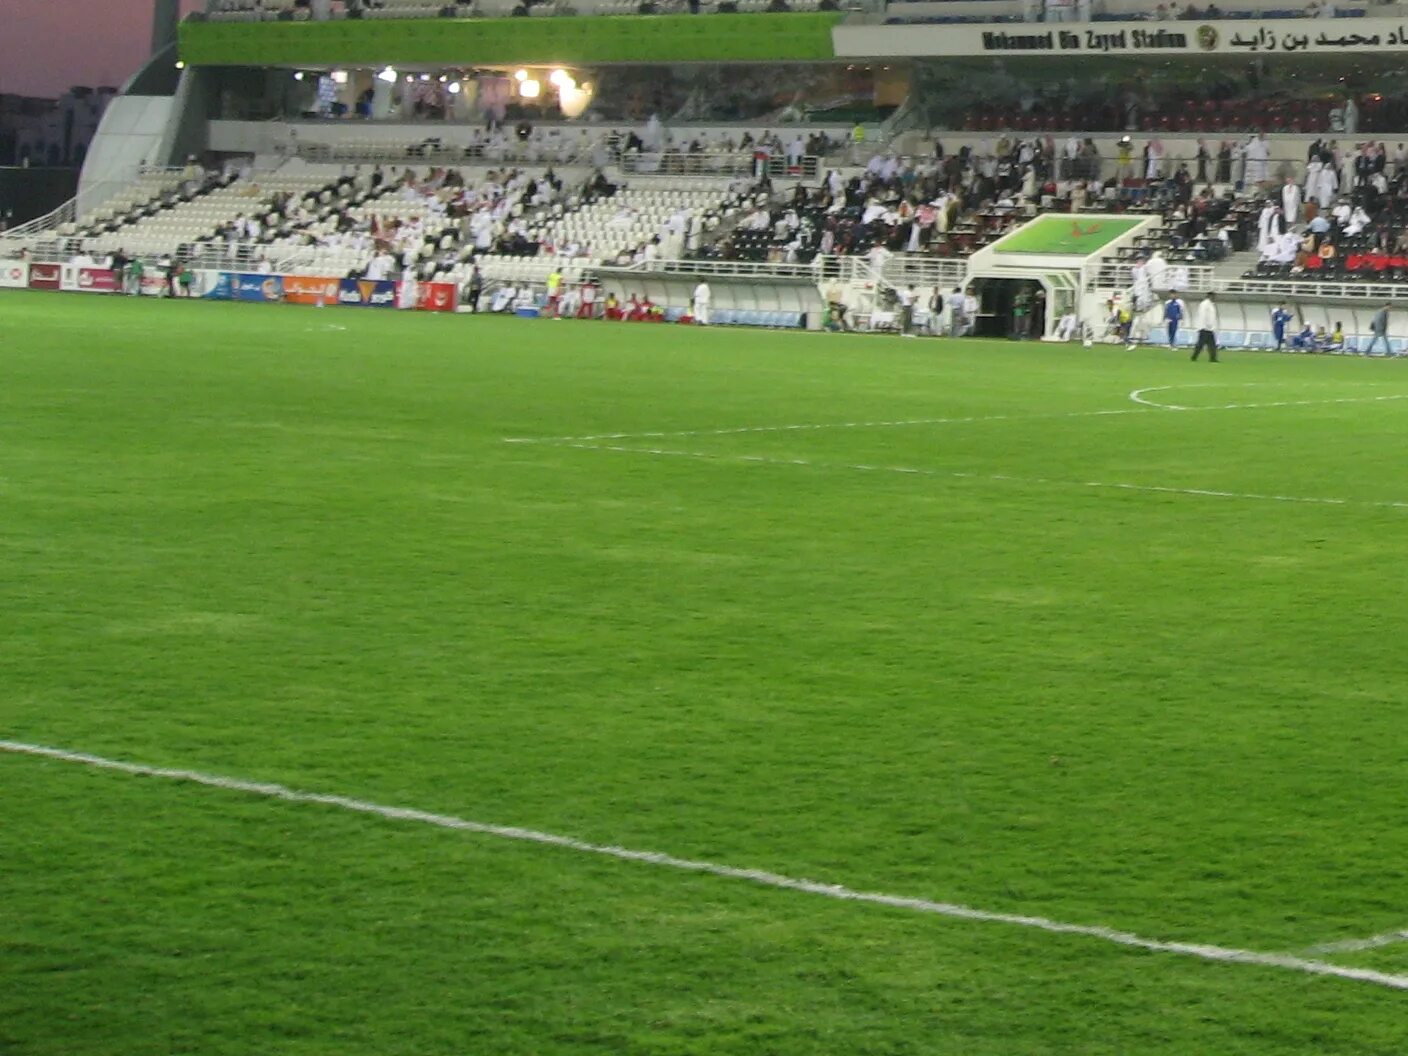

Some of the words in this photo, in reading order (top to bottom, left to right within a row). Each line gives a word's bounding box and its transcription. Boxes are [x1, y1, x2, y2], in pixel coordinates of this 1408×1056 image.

[1059, 30, 1081, 50] Bin
[1085, 29, 1127, 51] Zayed
[1131, 28, 1187, 49] Stadium
[1230, 27, 1276, 50] زايد
[1281, 32, 1308, 50] بن
[1315, 32, 1380, 46] محمد
